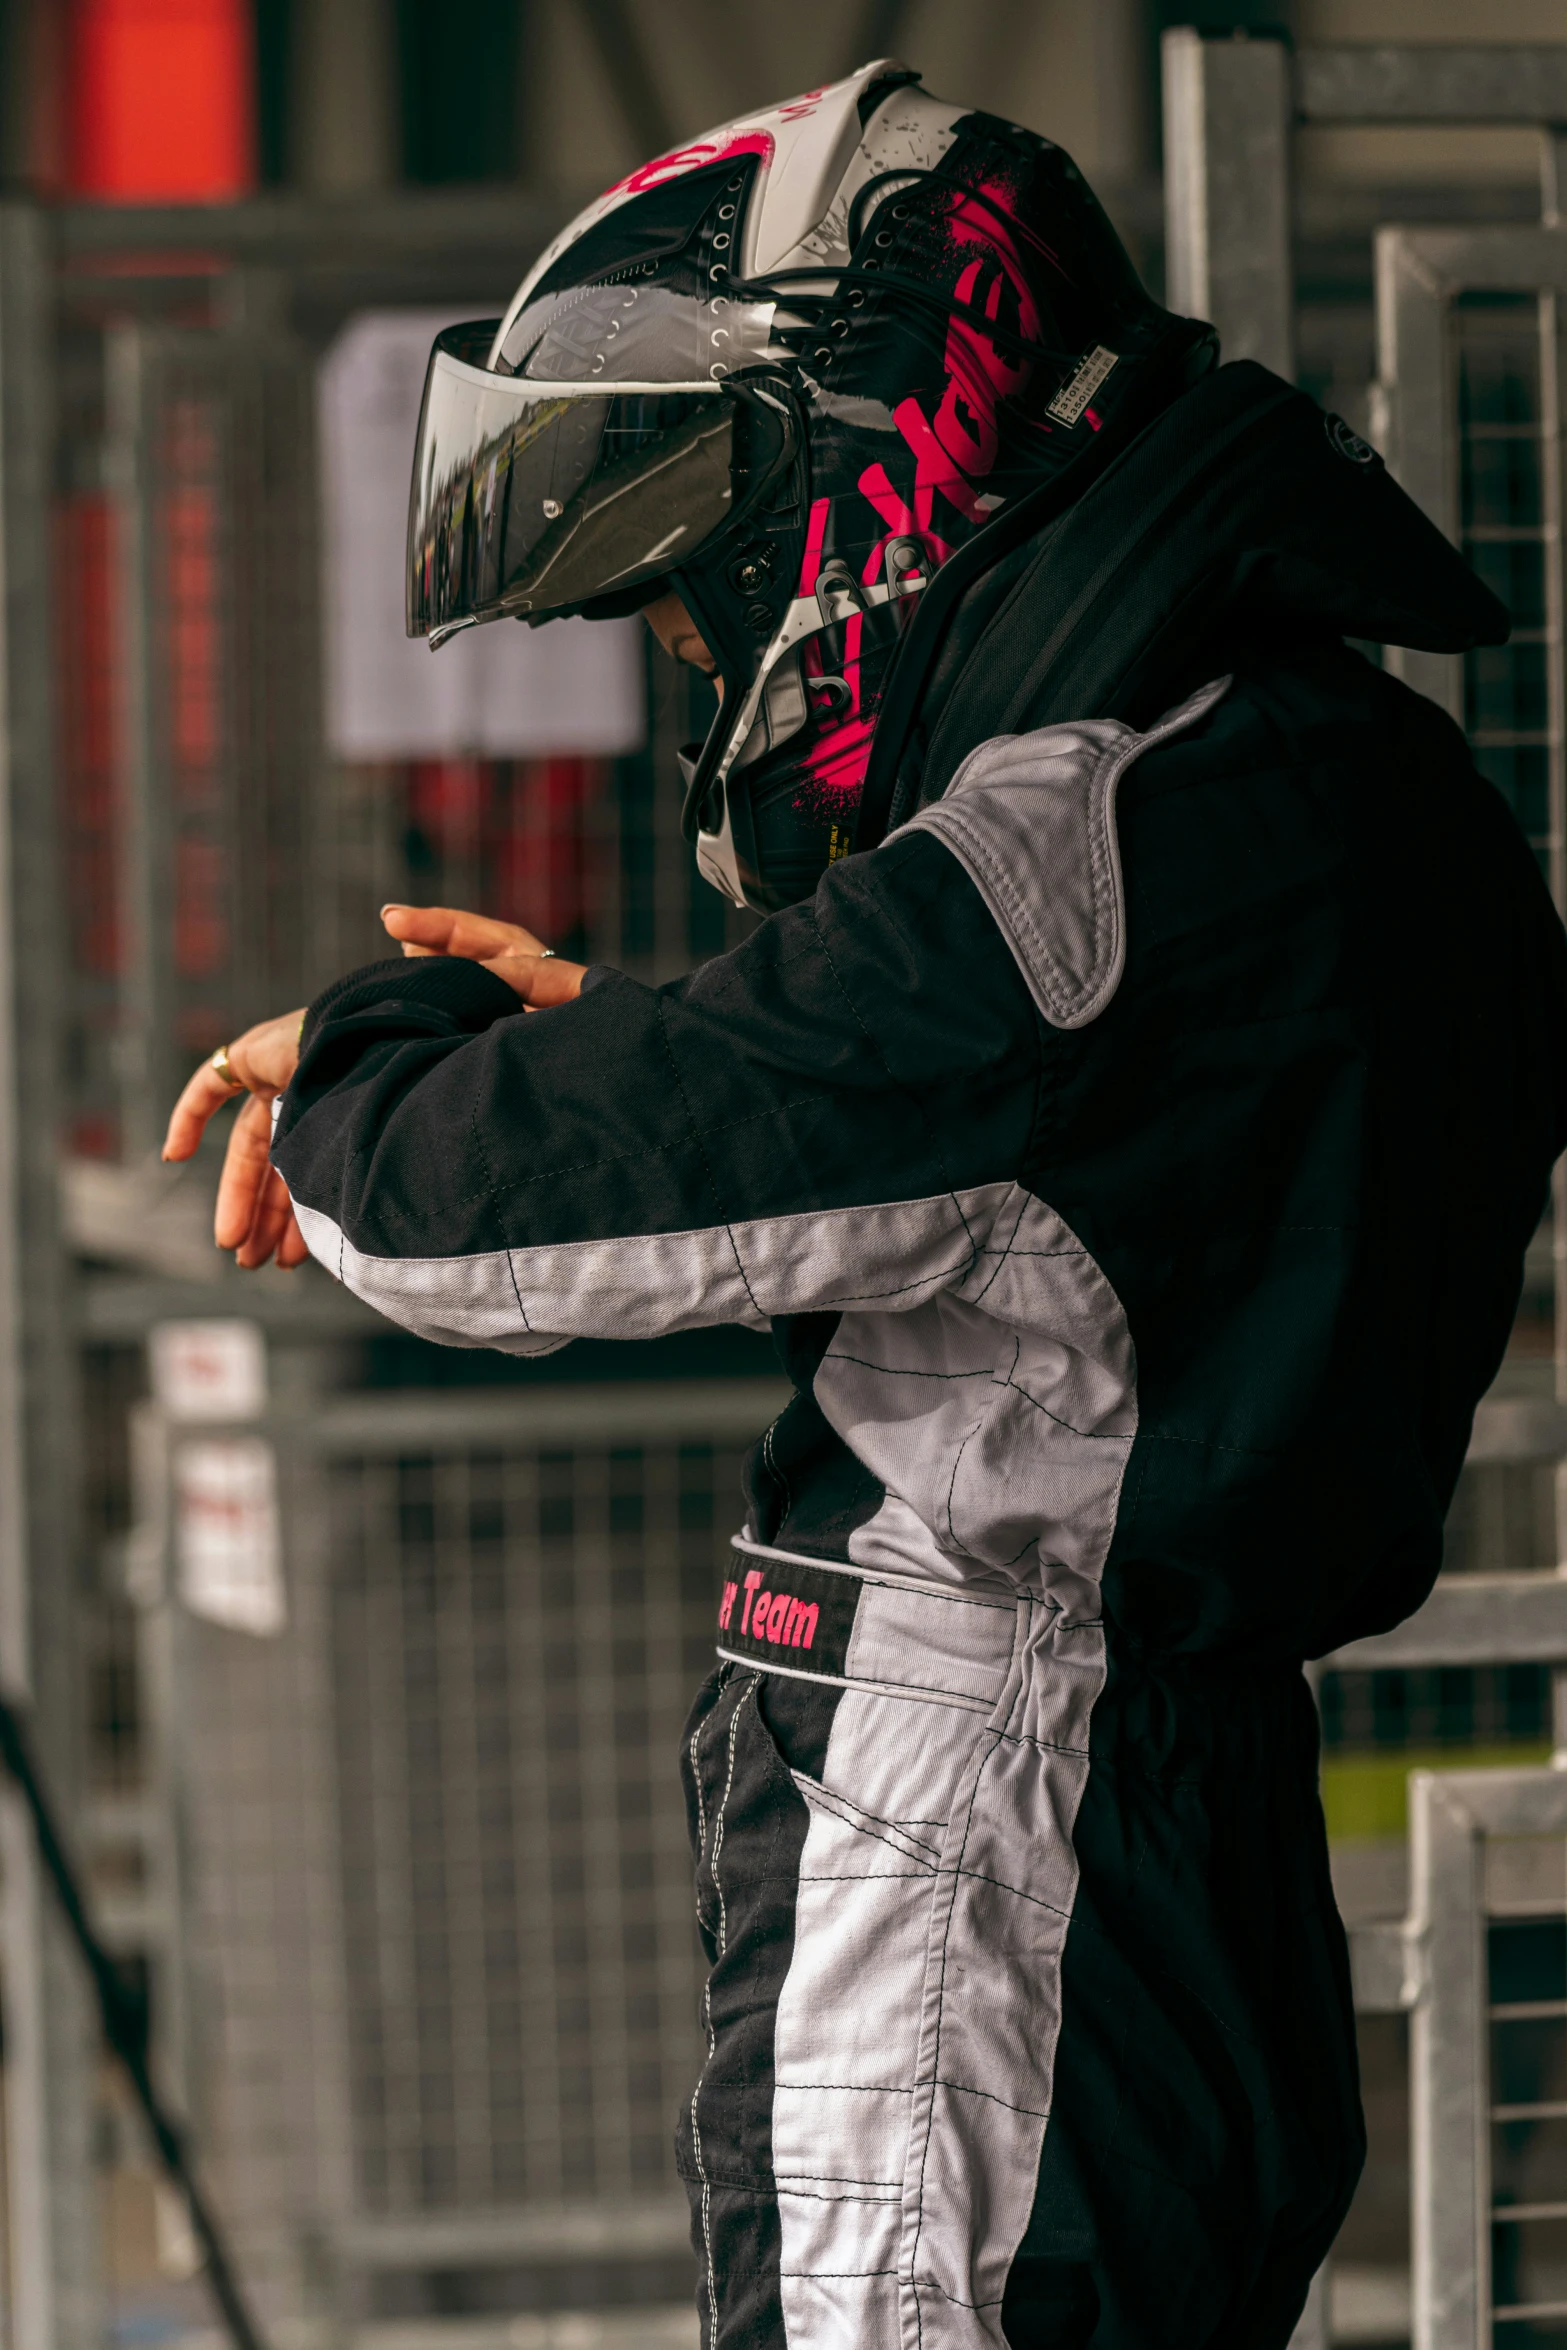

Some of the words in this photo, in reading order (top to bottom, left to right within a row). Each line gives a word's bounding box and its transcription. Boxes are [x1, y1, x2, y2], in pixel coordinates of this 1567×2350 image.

[830, 824, 838, 844] ONLY
[829, 844, 837, 859] USE
[741, 1570, 820, 1649] Team
